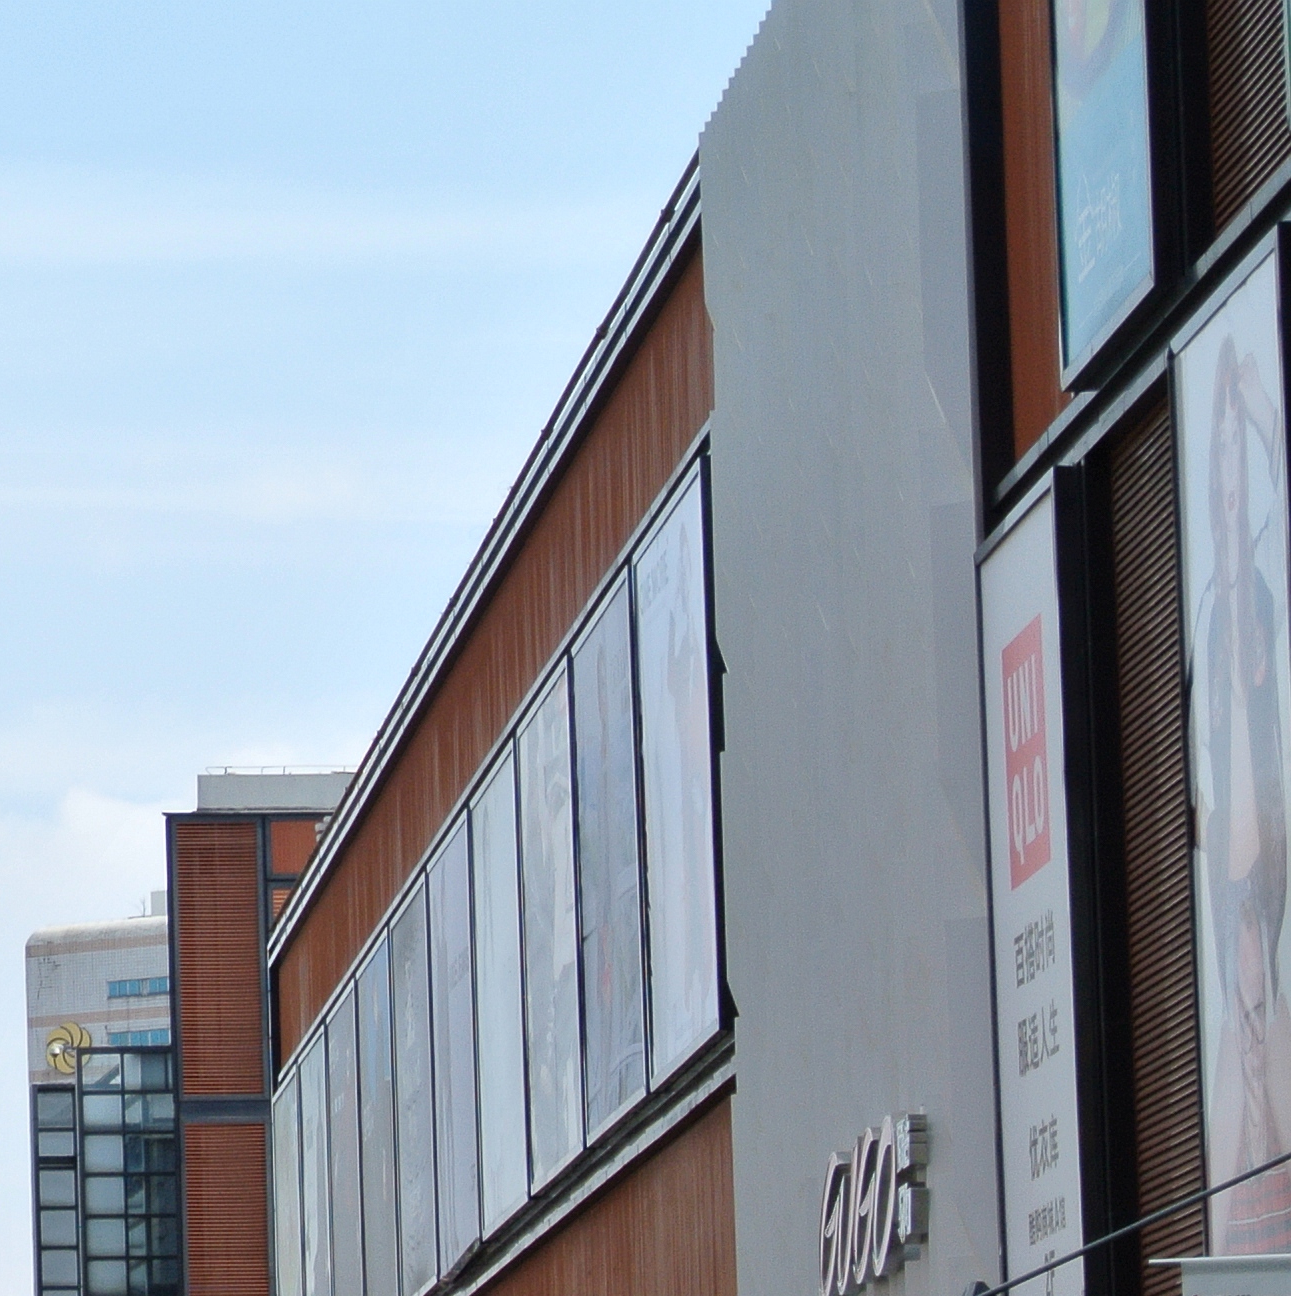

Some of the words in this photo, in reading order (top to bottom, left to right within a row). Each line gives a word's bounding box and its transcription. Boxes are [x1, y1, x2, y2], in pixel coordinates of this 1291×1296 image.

[1007, 653, 1038, 753] UNI
[1012, 755, 1045, 866] QLO
[1013, 909, 1057, 989] 百搭时尚
[1018, 999, 1060, 1077] 服适人生
[1028, 1114, 1060, 1181] 优衣库
